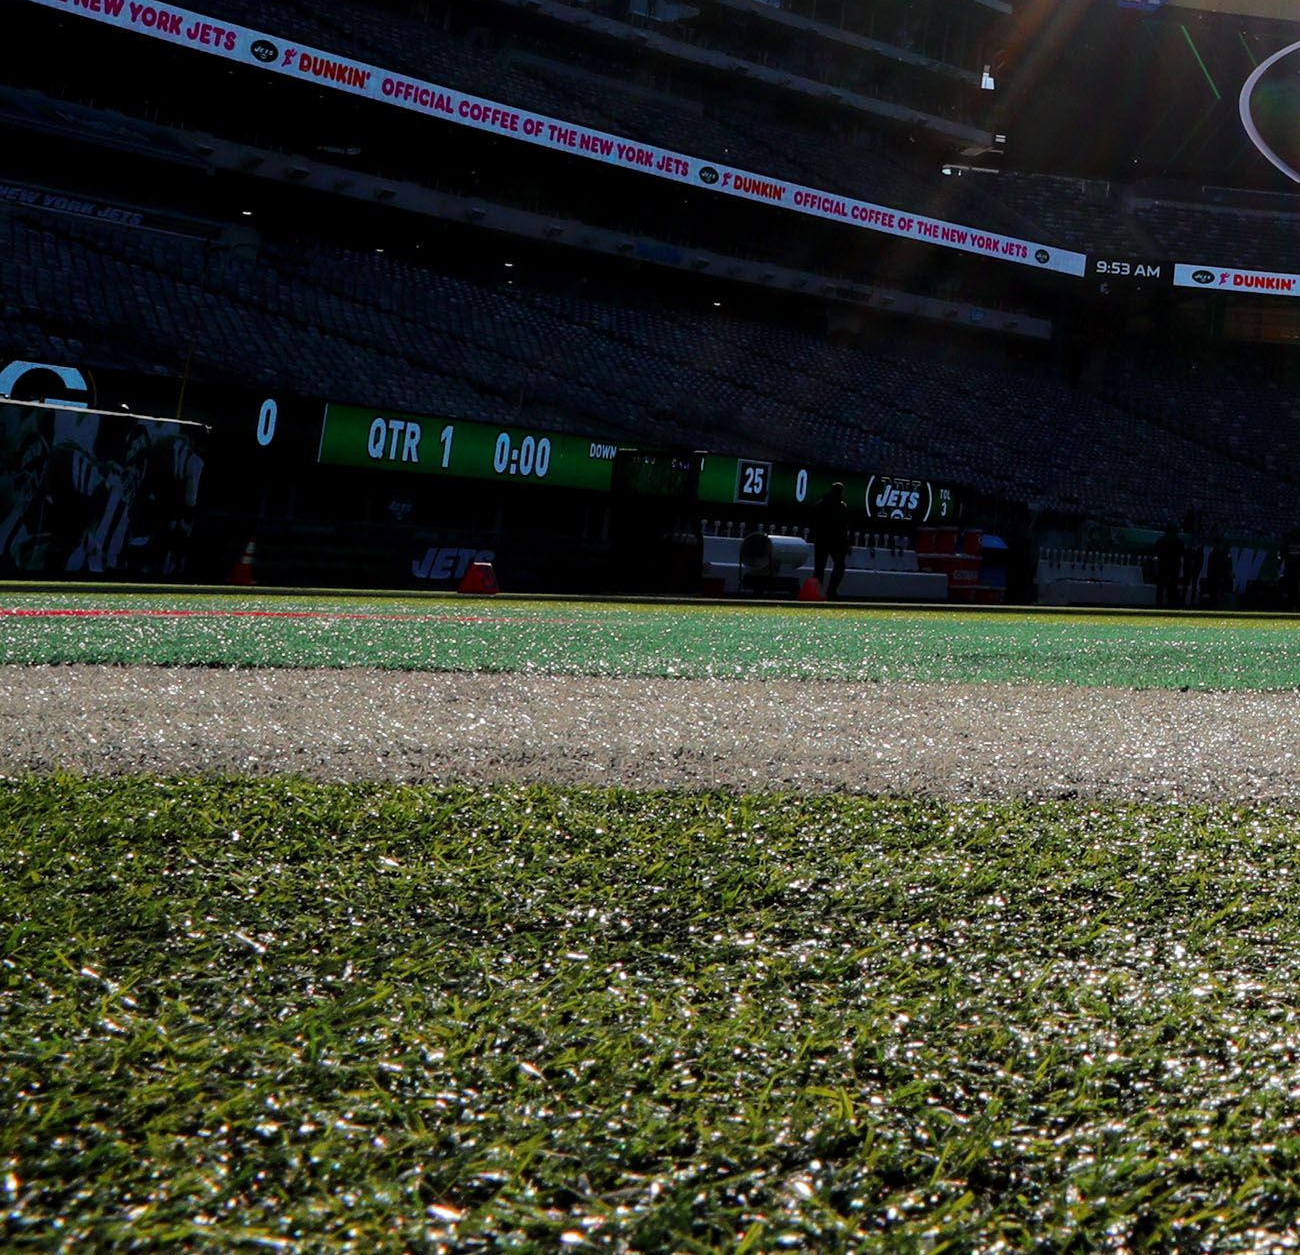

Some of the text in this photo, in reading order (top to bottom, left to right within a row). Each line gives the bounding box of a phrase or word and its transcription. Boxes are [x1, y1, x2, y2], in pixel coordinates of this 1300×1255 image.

[129, 2, 183, 35] YORK
[187, 22, 236, 50] JETS
[299, 53, 371, 88] DUNKIN'
[382, 78, 689, 176] OFFICIAL COFFEE OF THE NEW YORK JETS
[733, 175, 785, 200] DUNKIN'
[794, 191, 848, 217] OFFICIAL
[851, 206, 895, 228] COFFEE
[898, 217, 914, 232] OF
[917, 221, 939, 238] THE
[941, 227, 968, 245] NEW
[970, 233, 1000, 252] YORK
[1001, 242, 1028, 258] JETS
[1096, 260, 1161, 278] 9:53 AM
[1233, 274, 1296, 291] DUNKIN'
[256, 398, 278, 445] 0
[367, 417, 454, 468] QTR 1
[493, 432, 551, 478] 0:00
[589, 442, 617, 460] DOWN
[743, 467, 764, 495] 25
[795, 468, 809, 502] 0
[875, 484, 920, 510] JETS
[940, 502, 947, 517] 3
